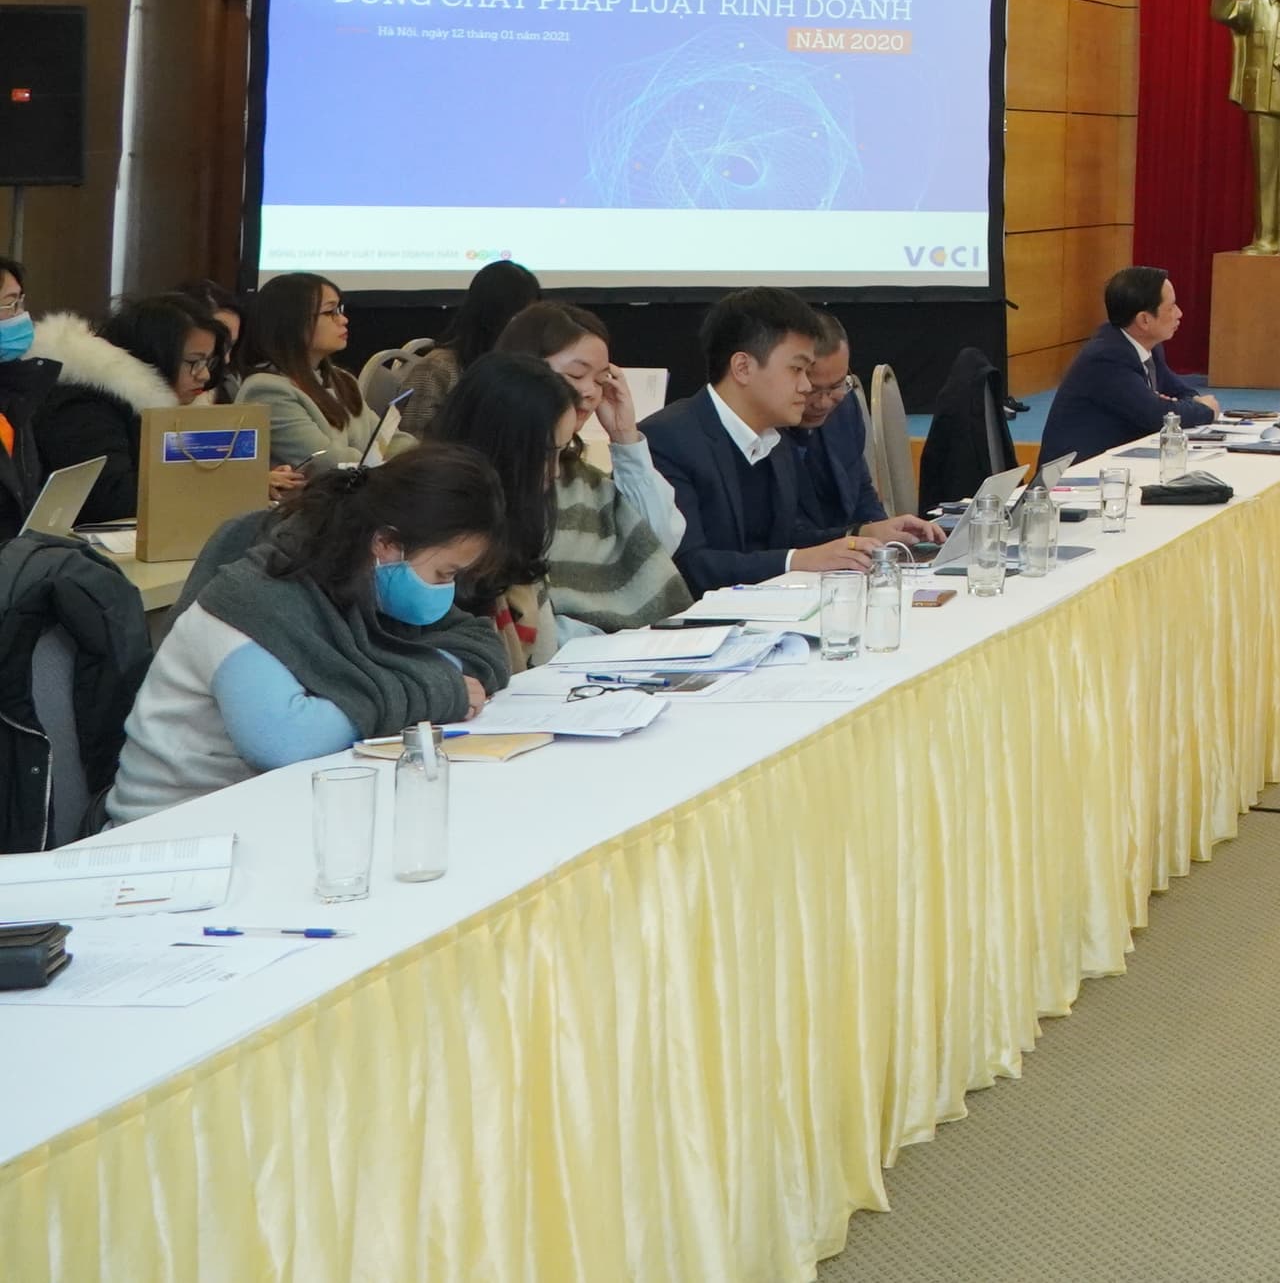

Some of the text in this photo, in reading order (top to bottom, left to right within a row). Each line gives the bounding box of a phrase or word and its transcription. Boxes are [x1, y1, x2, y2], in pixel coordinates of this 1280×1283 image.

[452, 27, 465, 39] 12
[500, 29, 514, 41] 01
[543, 30, 570, 42] 2021
[796, 29, 904, 51] NĂM 2020
[904, 245, 979, 269] VCCI
